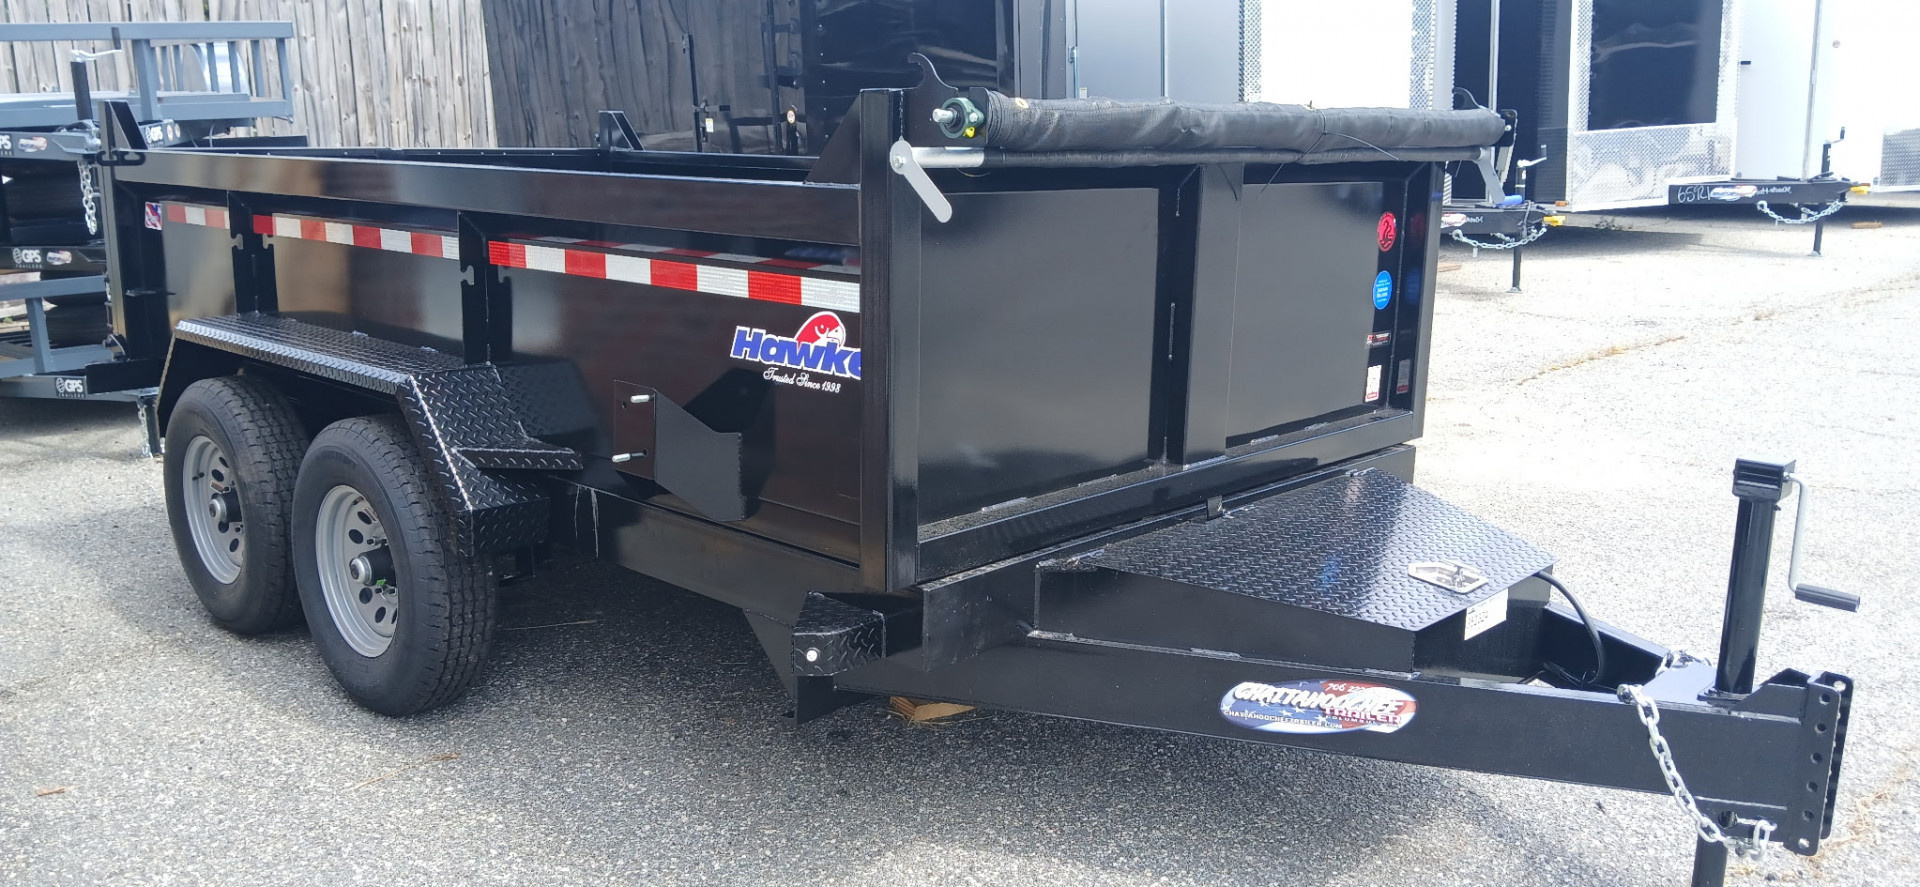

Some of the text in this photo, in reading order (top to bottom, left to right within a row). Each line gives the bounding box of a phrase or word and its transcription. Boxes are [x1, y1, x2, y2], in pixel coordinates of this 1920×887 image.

[0, 134, 12, 150] PS
[22, 249, 42, 263] GPS
[65, 379, 83, 393] GPS
[763, 367, 842, 393] Trusted Since 1998
[1325, 682, 1346, 691] 706
[1233, 681, 1403, 715] CHATTAHOOCHEE
[1322, 706, 1401, 724] TRAILER
